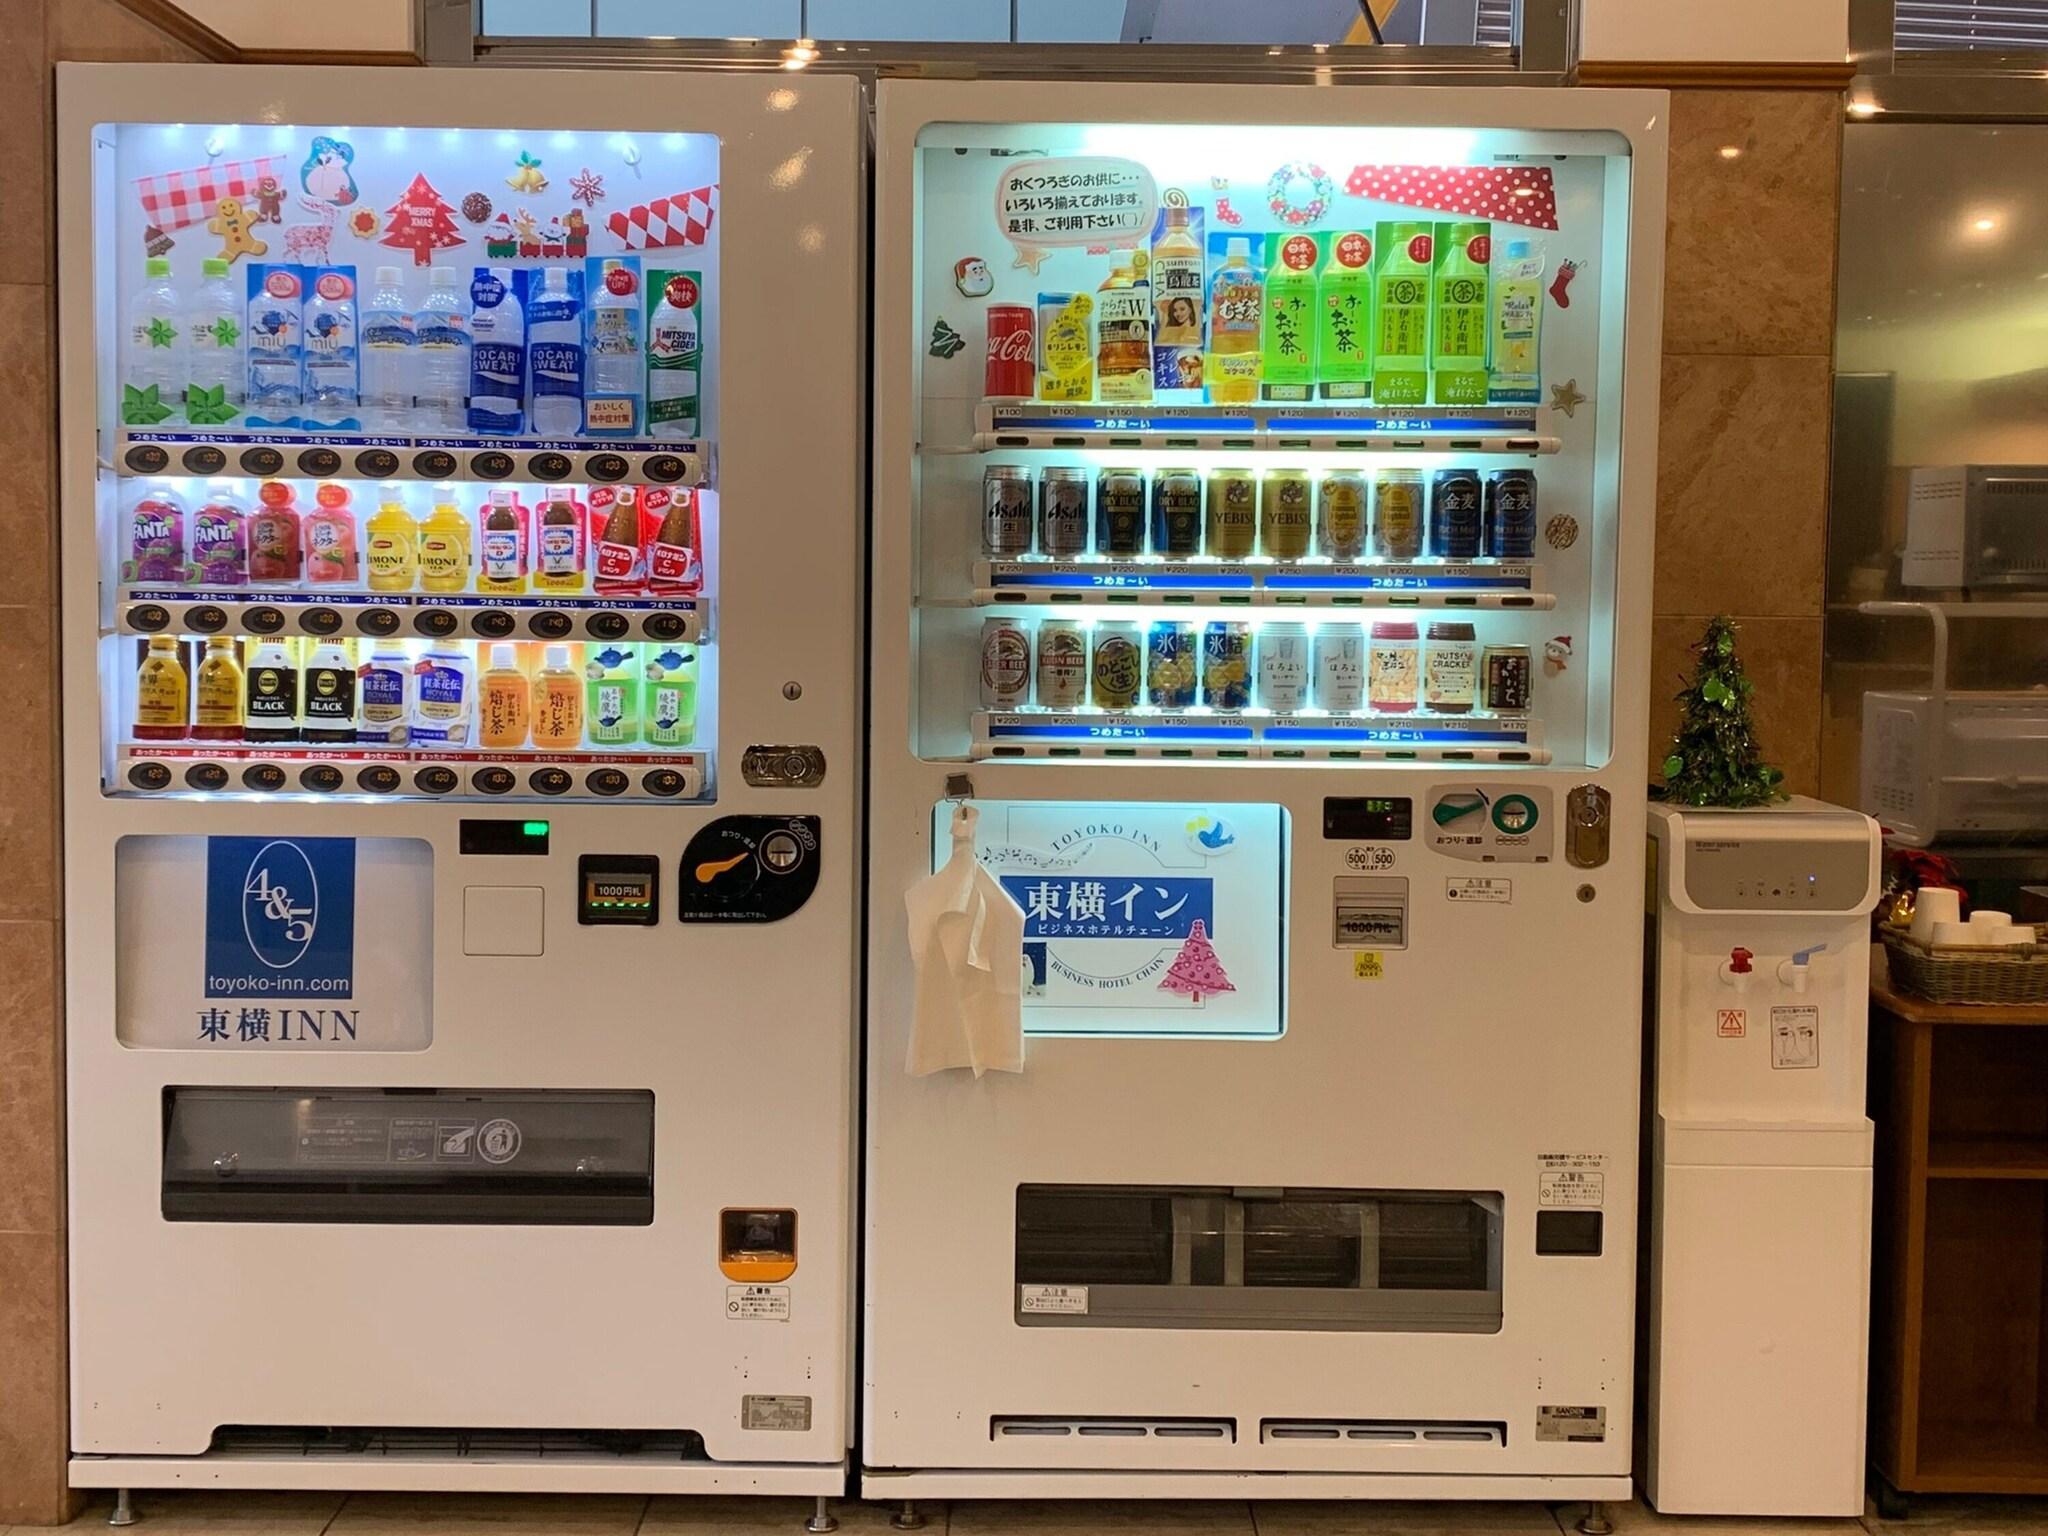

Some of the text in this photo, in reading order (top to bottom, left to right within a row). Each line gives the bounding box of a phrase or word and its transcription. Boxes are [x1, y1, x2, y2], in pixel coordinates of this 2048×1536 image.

[1005, 193, 1143, 211] いろいろ揃えております。
[409, 208, 436, 217] MERRY
[411, 217, 434, 227] XMAS
[1128, 299, 1145, 317] W
[1219, 299, 1260, 320] むぎ茶
[662, 330, 696, 340] MITSUYA
[1275, 311, 1302, 355] お茶
[1331, 309, 1358, 353] お茶
[670, 340, 696, 350] CIDER
[474, 350, 520, 363] POCARI
[1157, 351, 1177, 362] コク
[473, 361, 515, 372] SWEAT
[534, 361, 575, 370] SWEAT
[1157, 364, 1177, 374] キレ
[594, 403, 624, 411] おいしく
[664, 462, 677, 471] 120
[1445, 493, 1475, 510] 金麦
[1500, 493, 1530, 510] 金麦
[989, 500, 1030, 519] Asahi
[134, 521, 170, 540] FANTA
[195, 524, 234, 543] FANTA
[1066, 656, 1084, 665] BEER
[1098, 655, 1138, 677] のどごし
[1266, 663, 1303, 671] ほろよい
[1433, 660, 1471, 669] CRACKER
[252, 701, 285, 710] BLACK
[310, 701, 342, 711] BLACK
[489, 689, 505, 735] 焙じ茶
[548, 692, 565, 736] 焙じ茶
[1051, 823, 1162, 853] TOYOKO INN
[1349, 854, 1393, 864] 500 500
[598, 886, 641, 897] 1000円札
[1024, 881, 1189, 922] 東横イン
[1037, 923, 1175, 936] ビジネスホテルチェーン
[1050, 957, 1167, 989] BUSINESS HOTEL CHAIN
[209, 976, 349, 994] toyoko-inn.com
[197, 1008, 360, 1041] 東横INN
